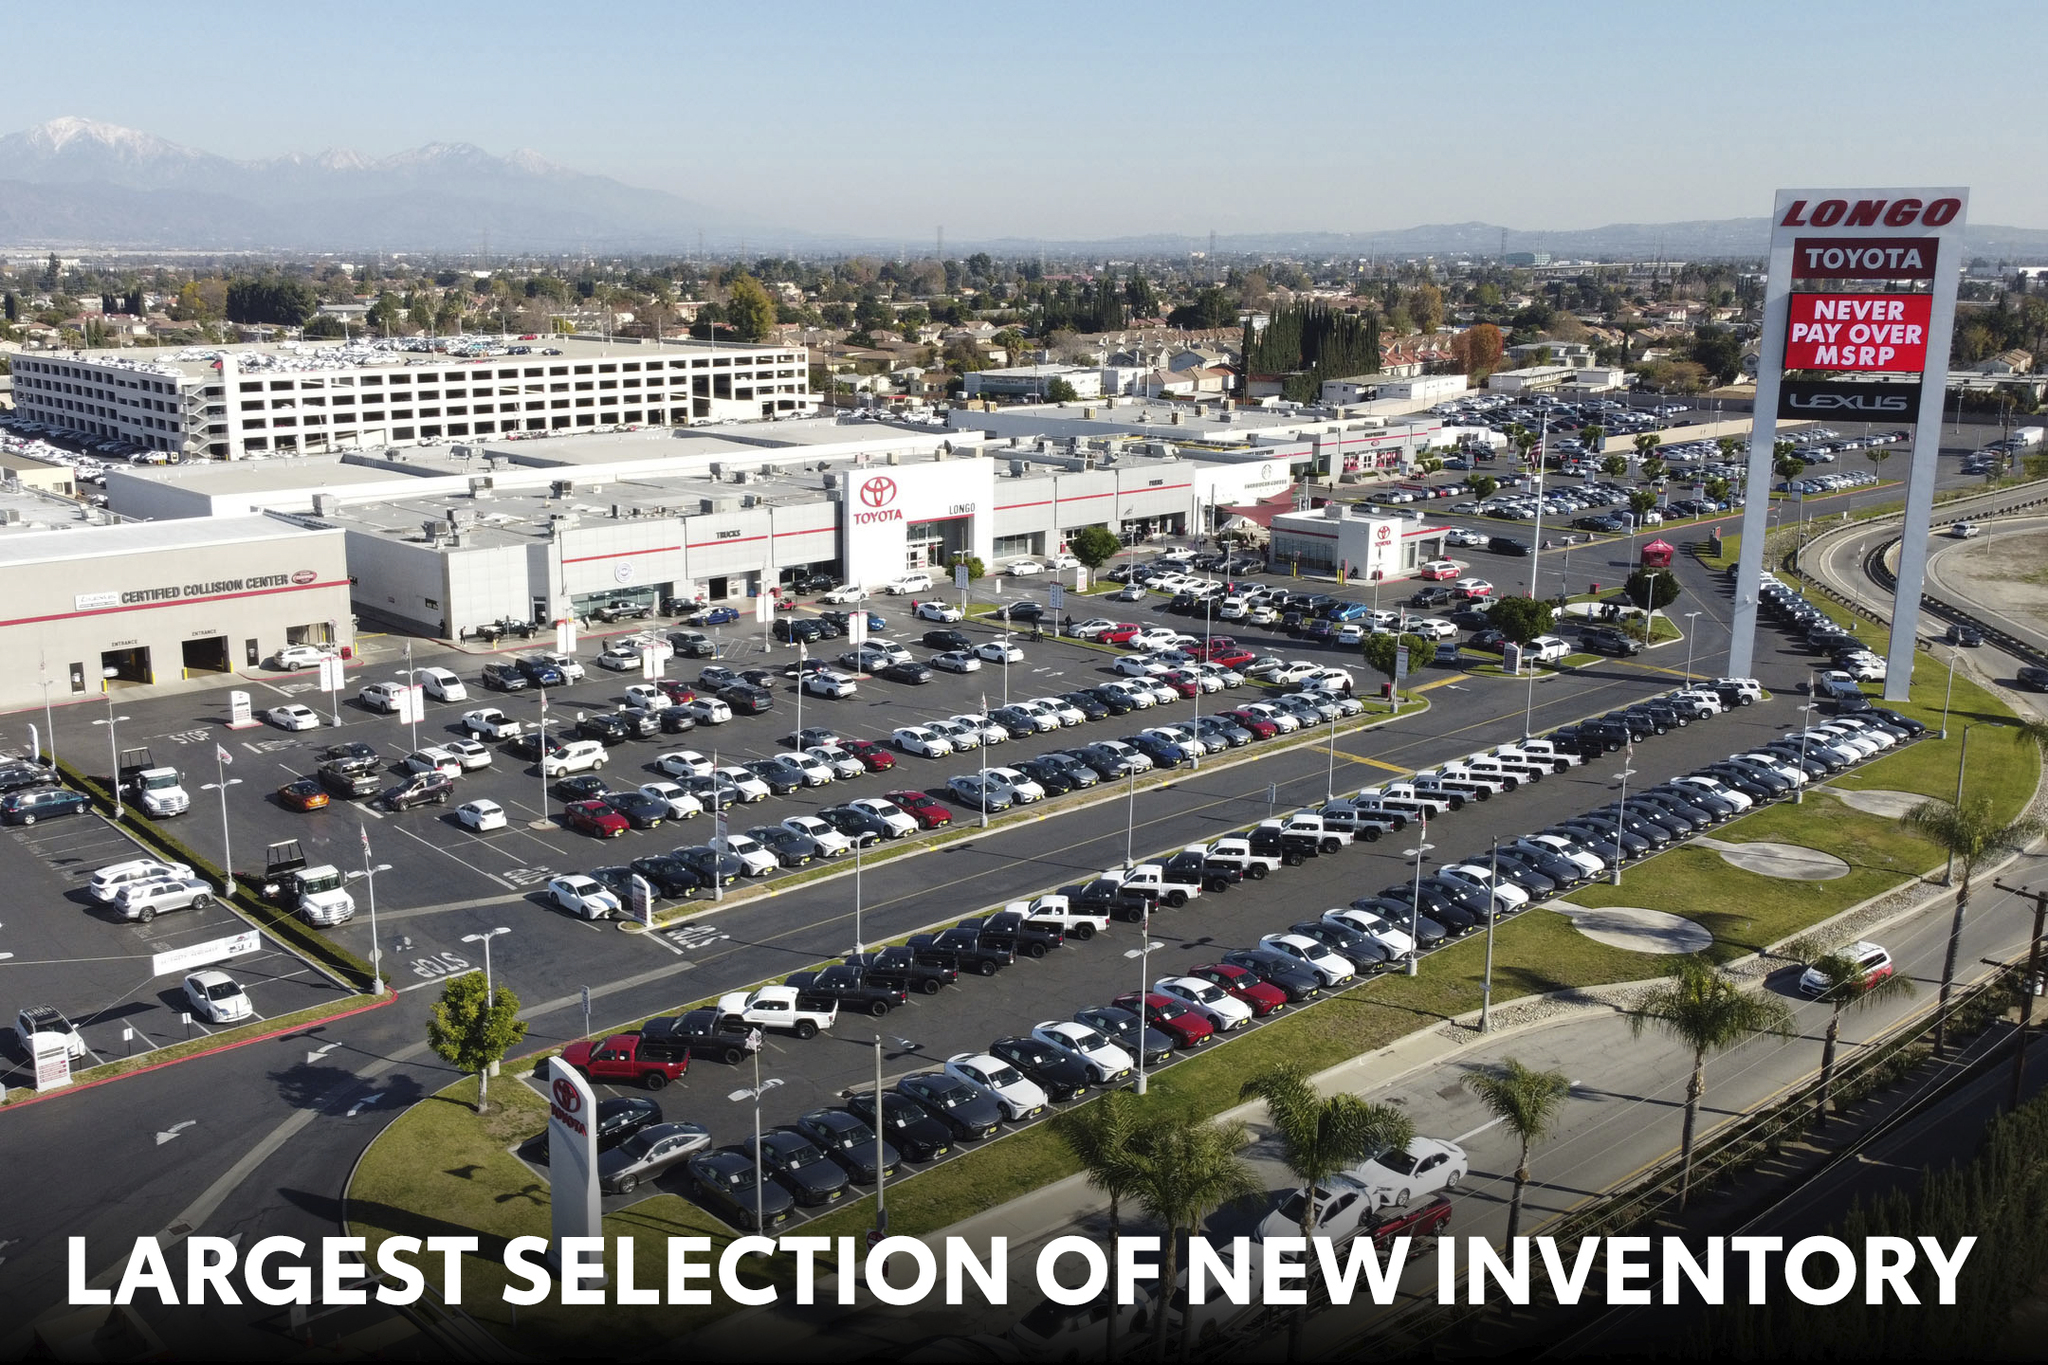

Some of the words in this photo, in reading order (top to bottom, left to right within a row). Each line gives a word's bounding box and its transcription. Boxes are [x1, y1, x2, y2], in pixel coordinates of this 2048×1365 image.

[1781, 198, 1962, 227] LONGO
[1805, 248, 1923, 270] TOYOTA
[1814, 300, 1905, 321] NEVER
[1791, 323, 1843, 343] PAY
[1849, 323, 1923, 344] OVER
[1814, 345, 1896, 366] MSRP
[1789, 393, 1908, 411] LEXUS
[853, 508, 903, 525] TOYOTA
[949, 502, 976, 515] LONGO
[715, 529, 742, 540] TRUCKS
[121, 586, 181, 604] CERTIFIED
[183, 579, 244, 597] COLLISION
[245, 573, 289, 590] CENTER
[111, 639, 138, 648] ENTRANCE
[191, 629, 217, 637] ENTRANCE
[168, 730, 211, 744] STOP
[411, 951, 470, 978] STOP
[550, 1102, 587, 1138] TOYOTA
